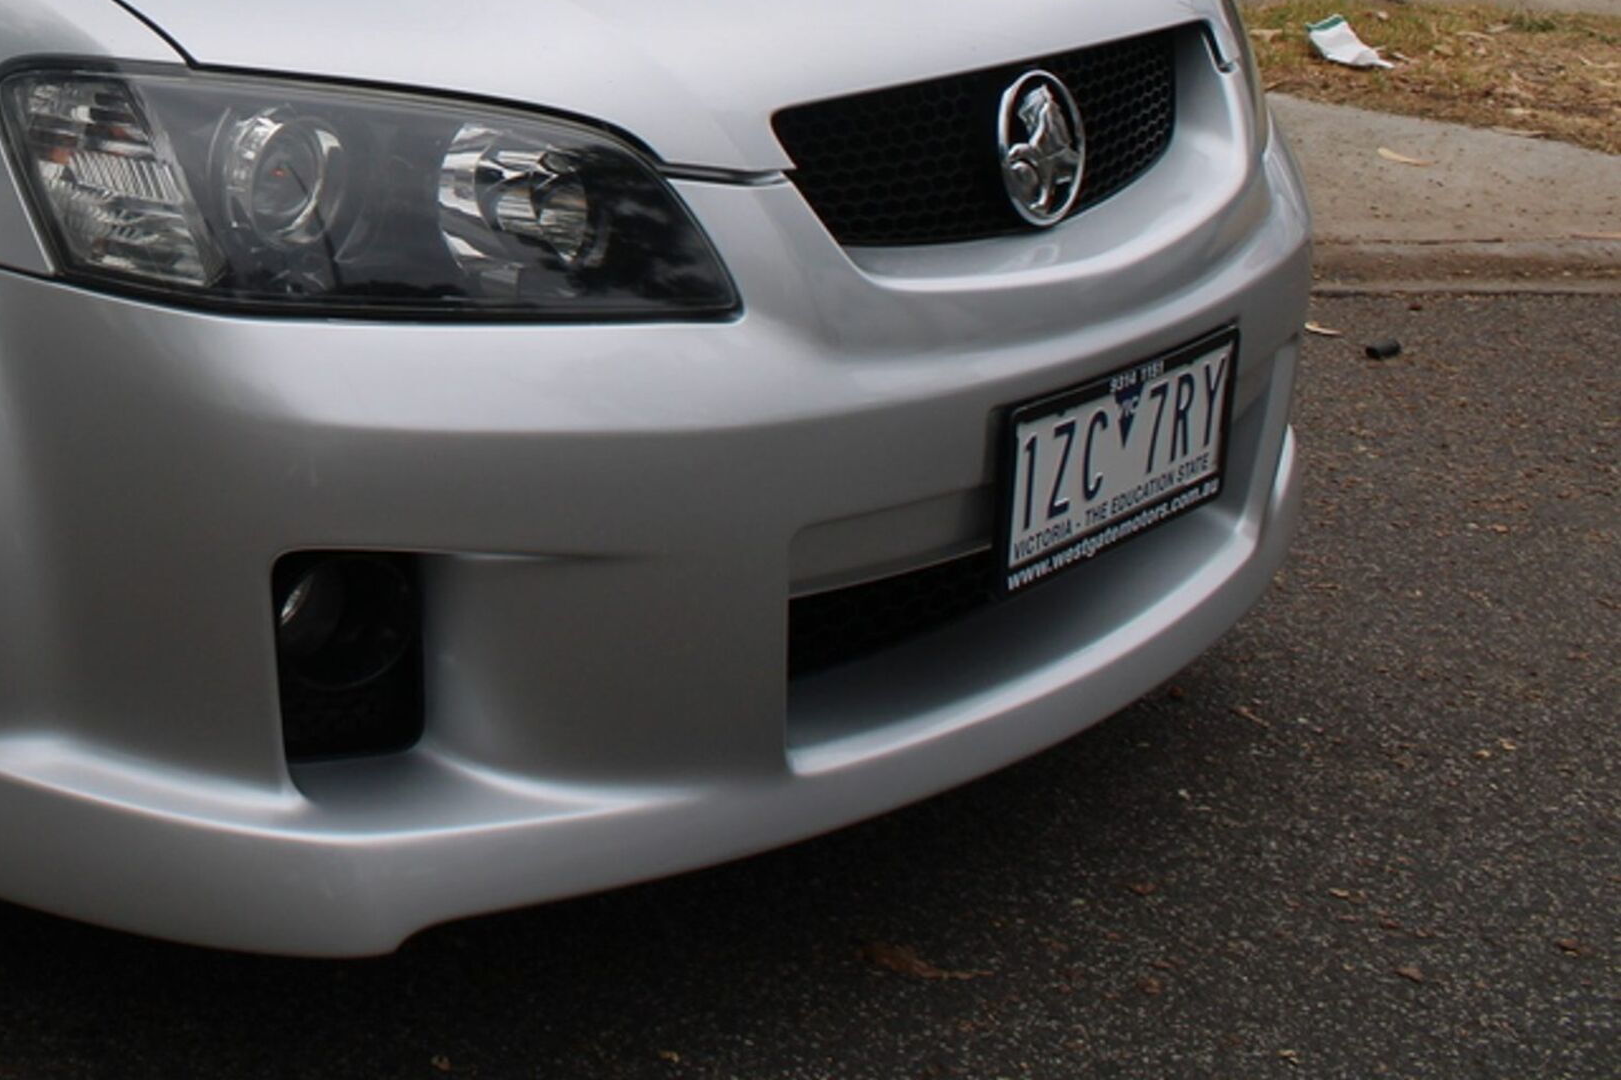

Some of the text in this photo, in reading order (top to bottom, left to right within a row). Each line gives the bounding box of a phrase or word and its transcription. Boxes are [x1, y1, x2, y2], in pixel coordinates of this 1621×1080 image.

[1023, 355, 1227, 531] 1ZC 7RY
[1007, 477, 1220, 591] www.westgatemotors.com.au
[1013, 519, 1073, 561] VICTORIA
[1084, 497, 1112, 526] THE
[1110, 475, 1175, 517] EDUCATION
[1176, 452, 1210, 483] STATE
